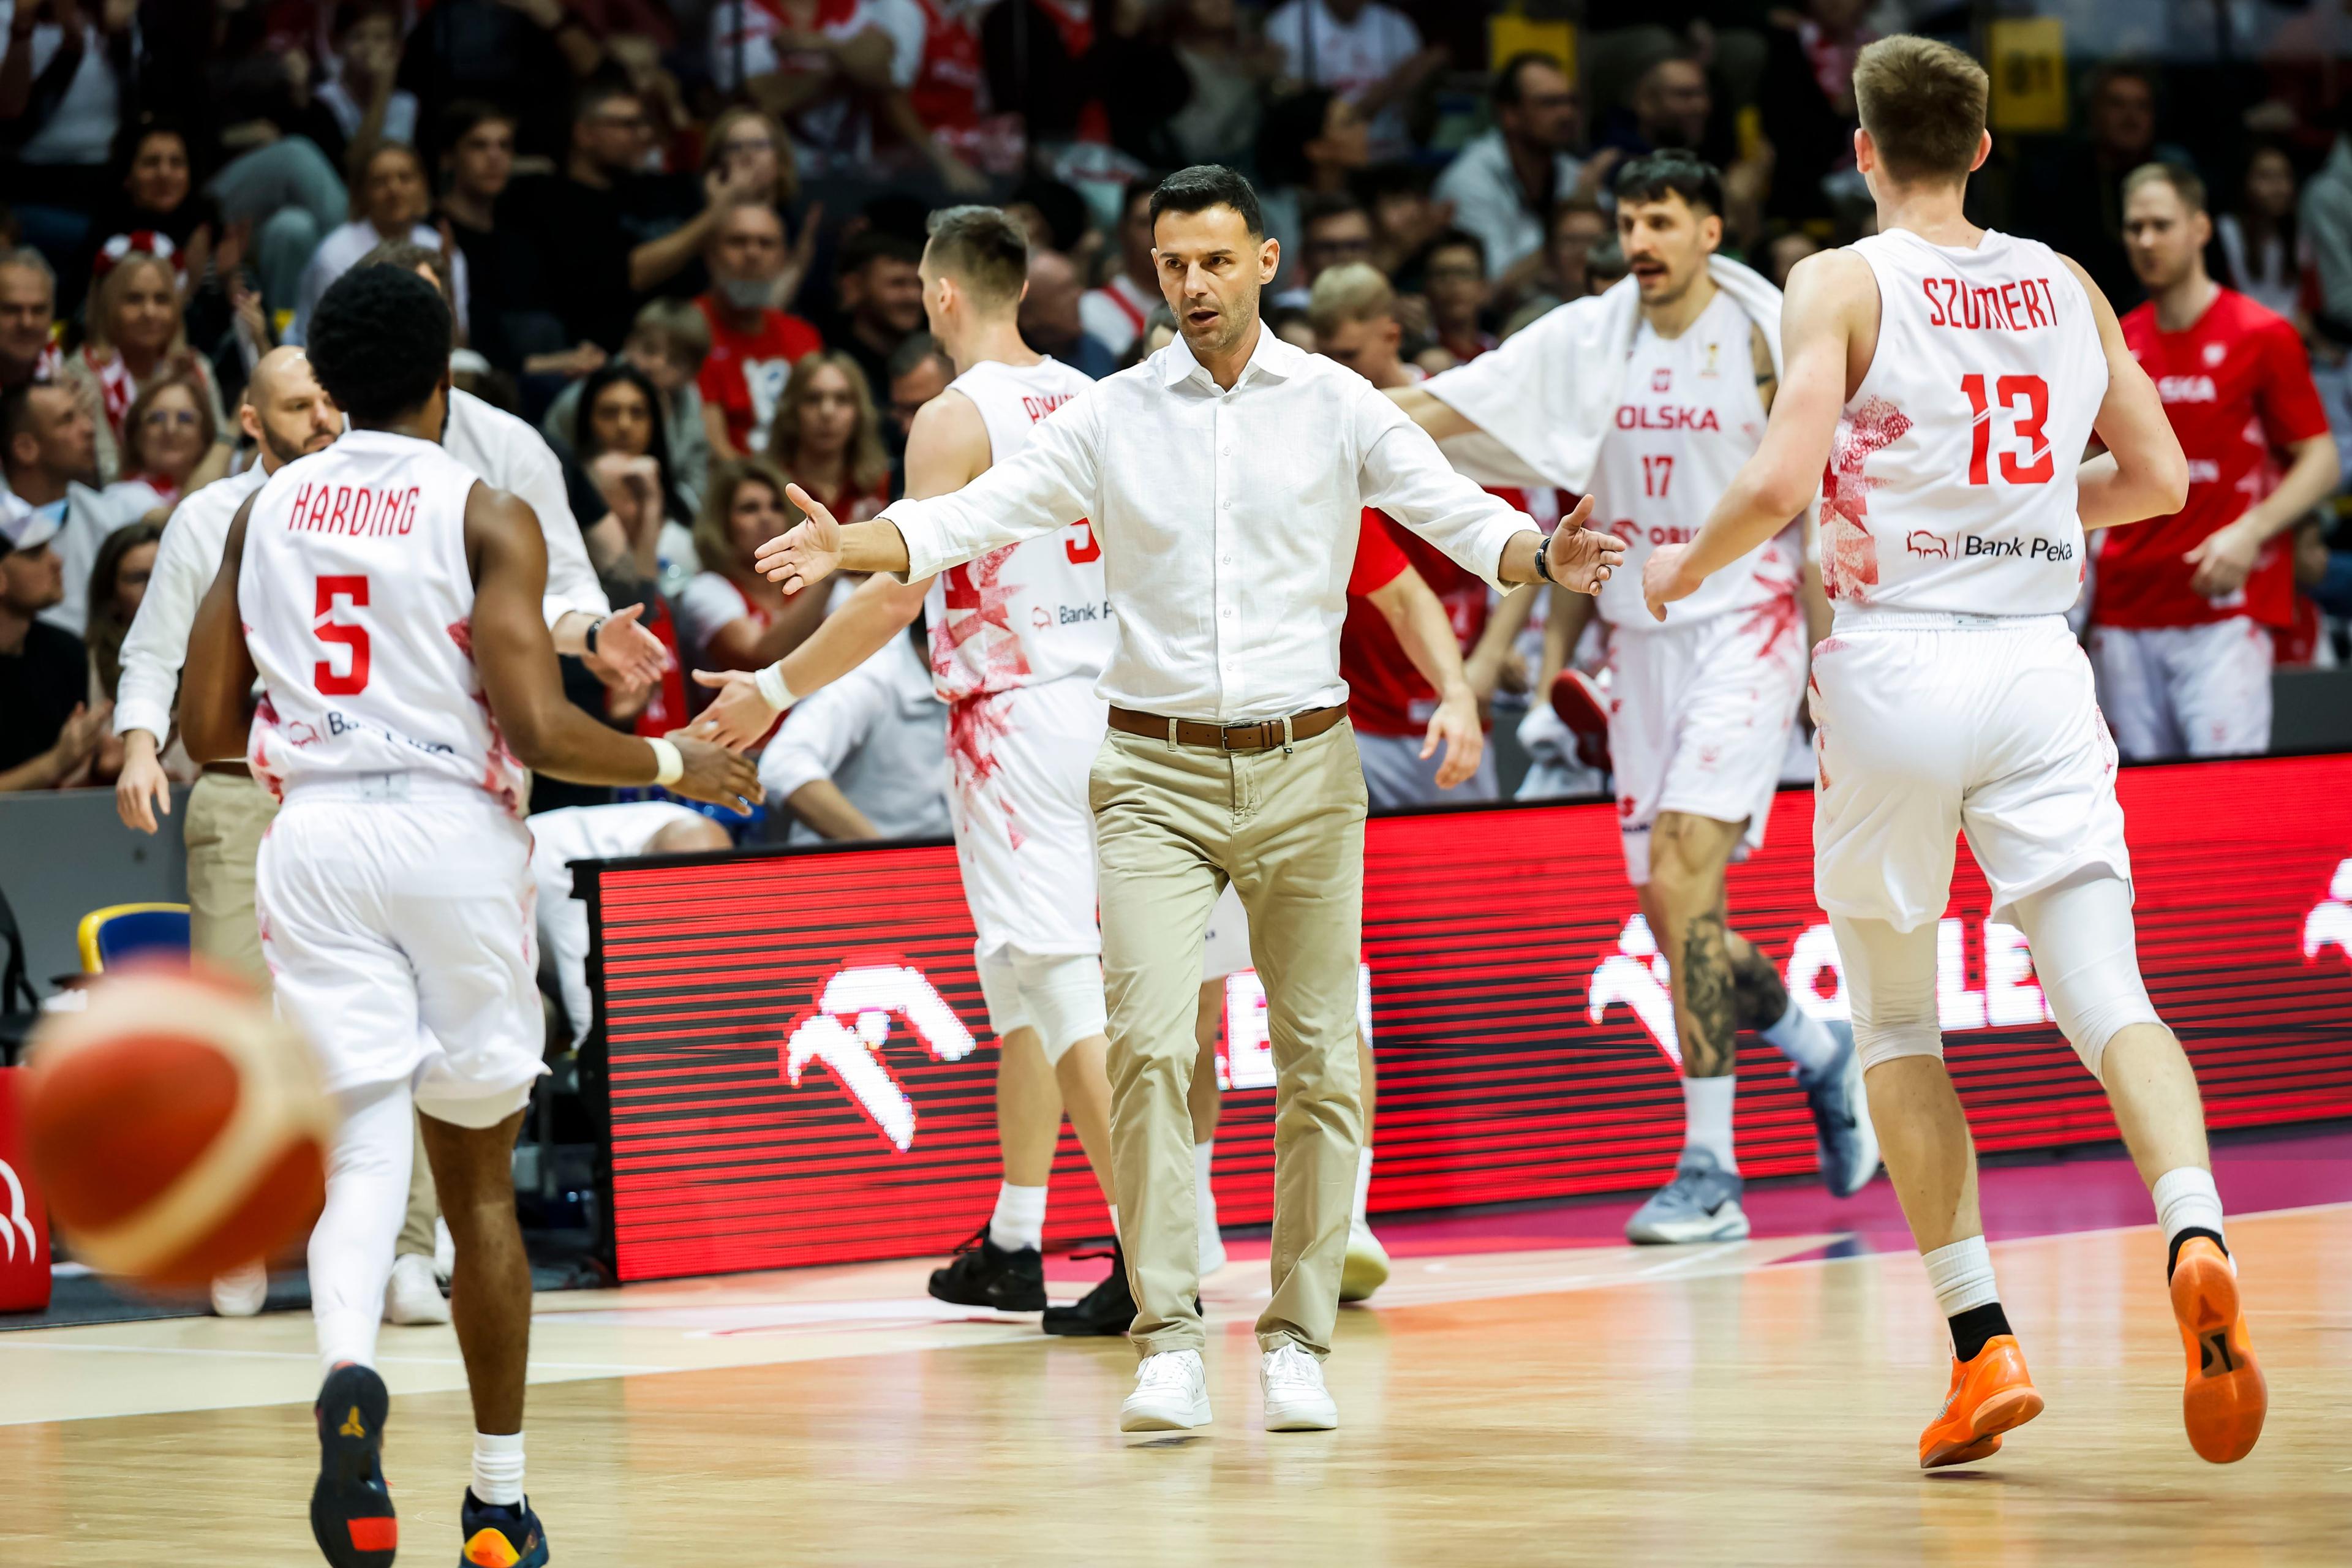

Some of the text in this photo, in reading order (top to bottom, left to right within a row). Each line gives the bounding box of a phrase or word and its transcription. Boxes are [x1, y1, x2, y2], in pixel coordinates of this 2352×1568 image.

[1923, 277, 2057, 332] SZUMERT
[1615, 405, 1720, 432] OLSKA
[1960, 374, 2055, 486] 13
[1642, 454, 1675, 499] 17
[288, 482, 420, 537] HARDING
[1965, 535, 2073, 562] Bank Peka
[313, 575, 371, 696] 5
[1059, 601, 1098, 625] Bank
[1785, 916, 2057, 1031] OLE
